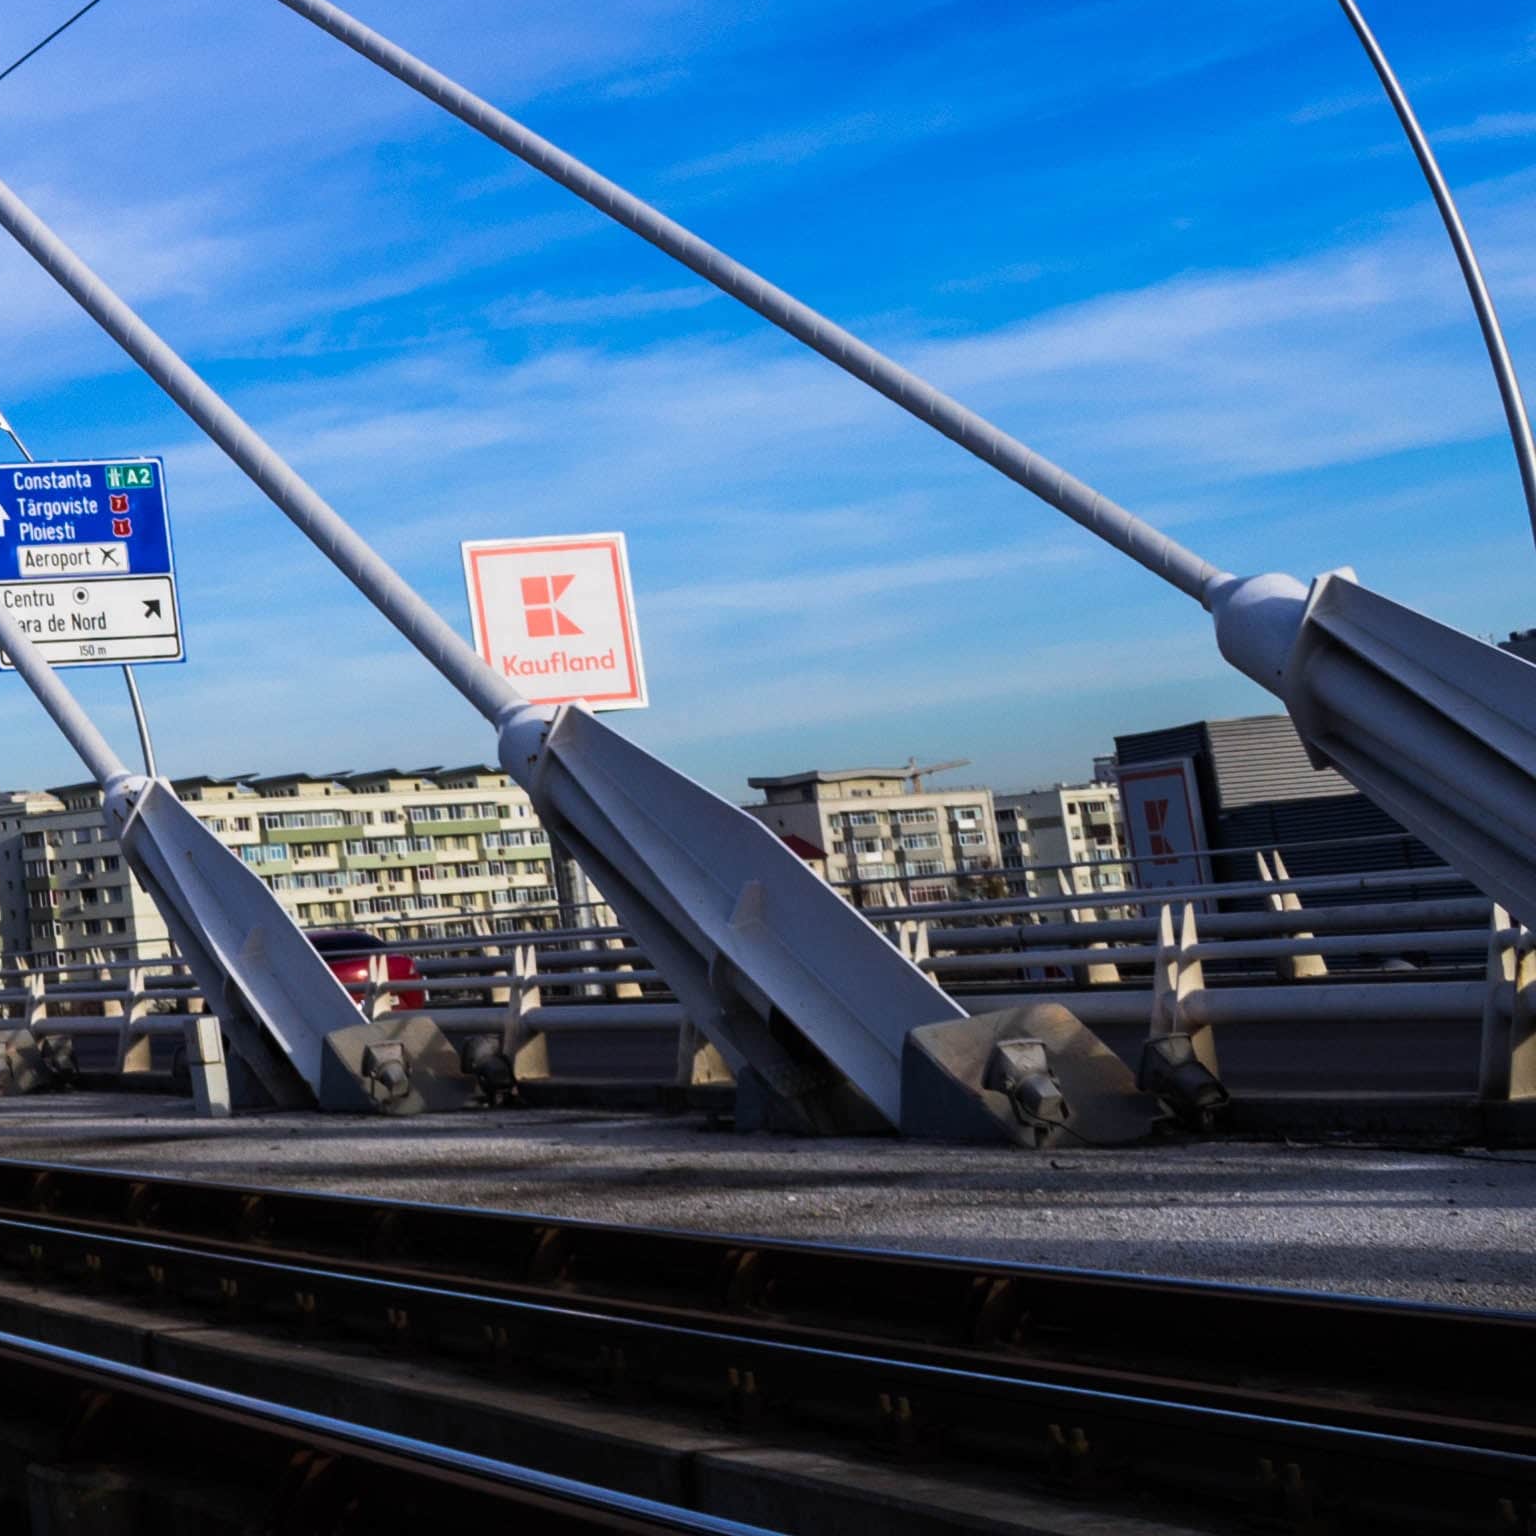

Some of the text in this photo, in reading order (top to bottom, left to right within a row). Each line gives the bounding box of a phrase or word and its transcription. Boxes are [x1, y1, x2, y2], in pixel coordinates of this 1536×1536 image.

[127, 468, 151, 484] A2
[25, 548, 91, 571] Aeroport
[3, 590, 55, 608] Centru
[48, 614, 66, 632] de
[71, 612, 107, 631] Nord
[79, 645, 107, 656] 150 m
[502, 648, 615, 676] Kaufland
